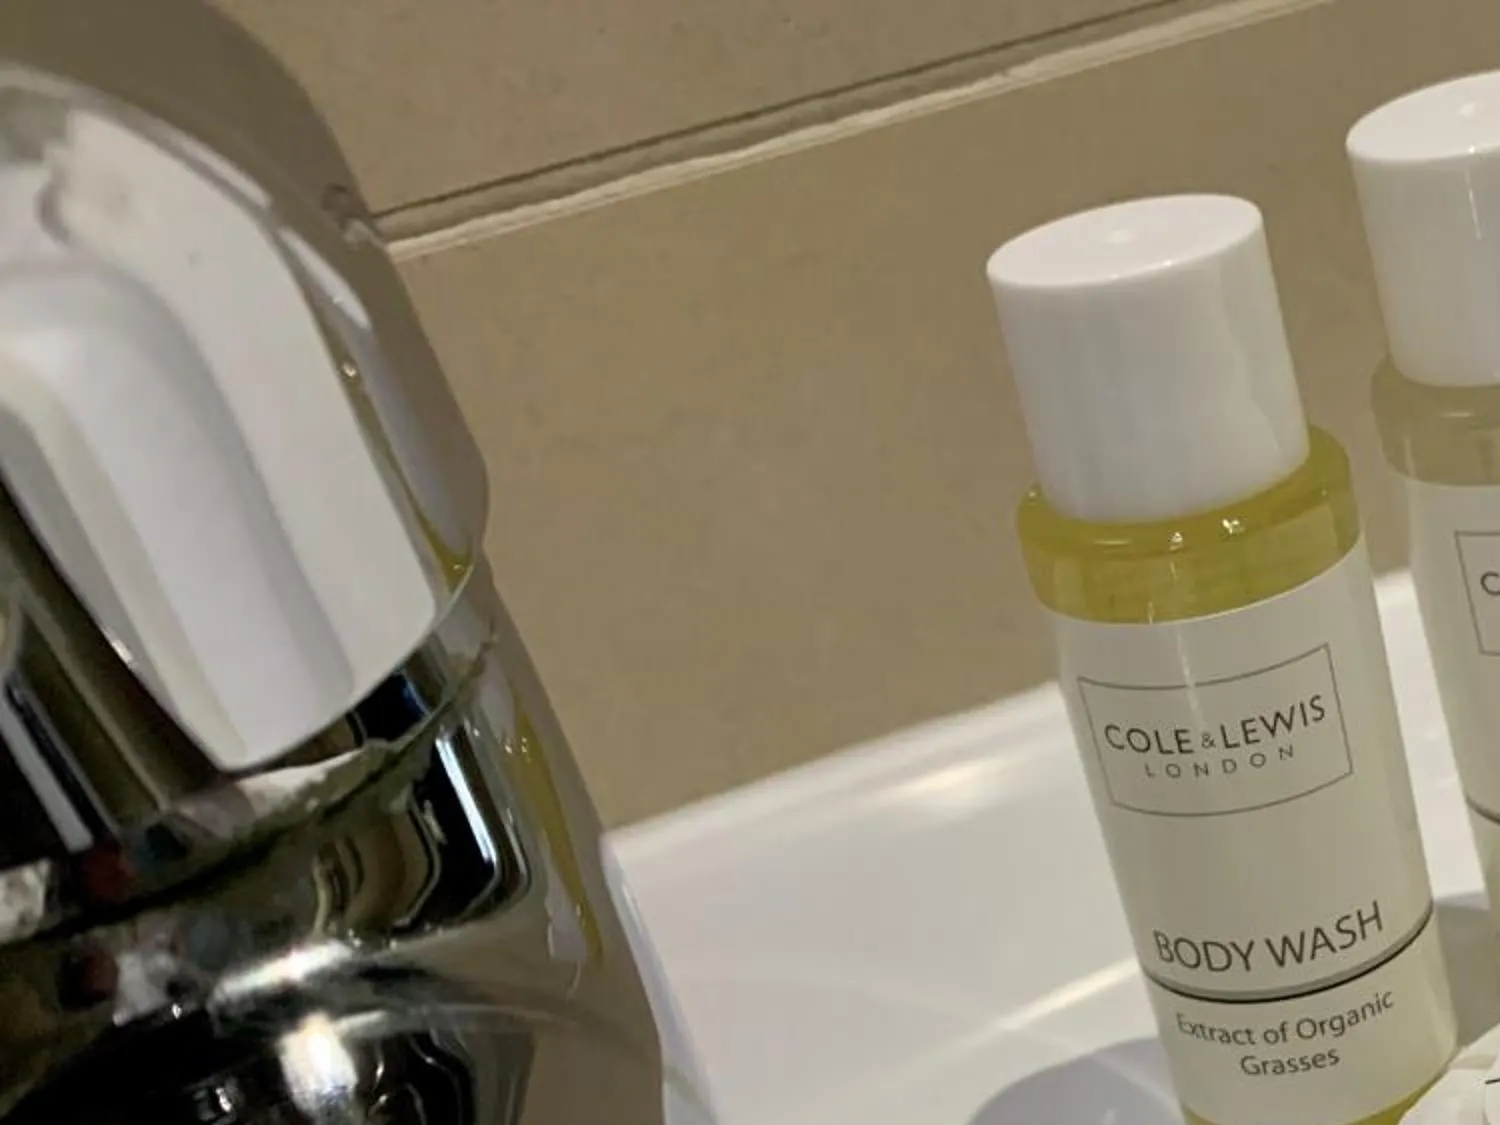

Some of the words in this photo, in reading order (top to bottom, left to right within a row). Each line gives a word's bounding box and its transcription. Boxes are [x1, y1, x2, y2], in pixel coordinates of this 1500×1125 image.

[1145, 744, 1295, 779] LONDON
[1153, 929, 1255, 973] BODY
[1265, 900, 1384, 968] WASH
[1176, 1012, 1256, 1046] Extract
[1263, 1021, 1289, 1044] of
[1296, 989, 1395, 1041] Organic
[1240, 1048, 1341, 1077] Grasses
